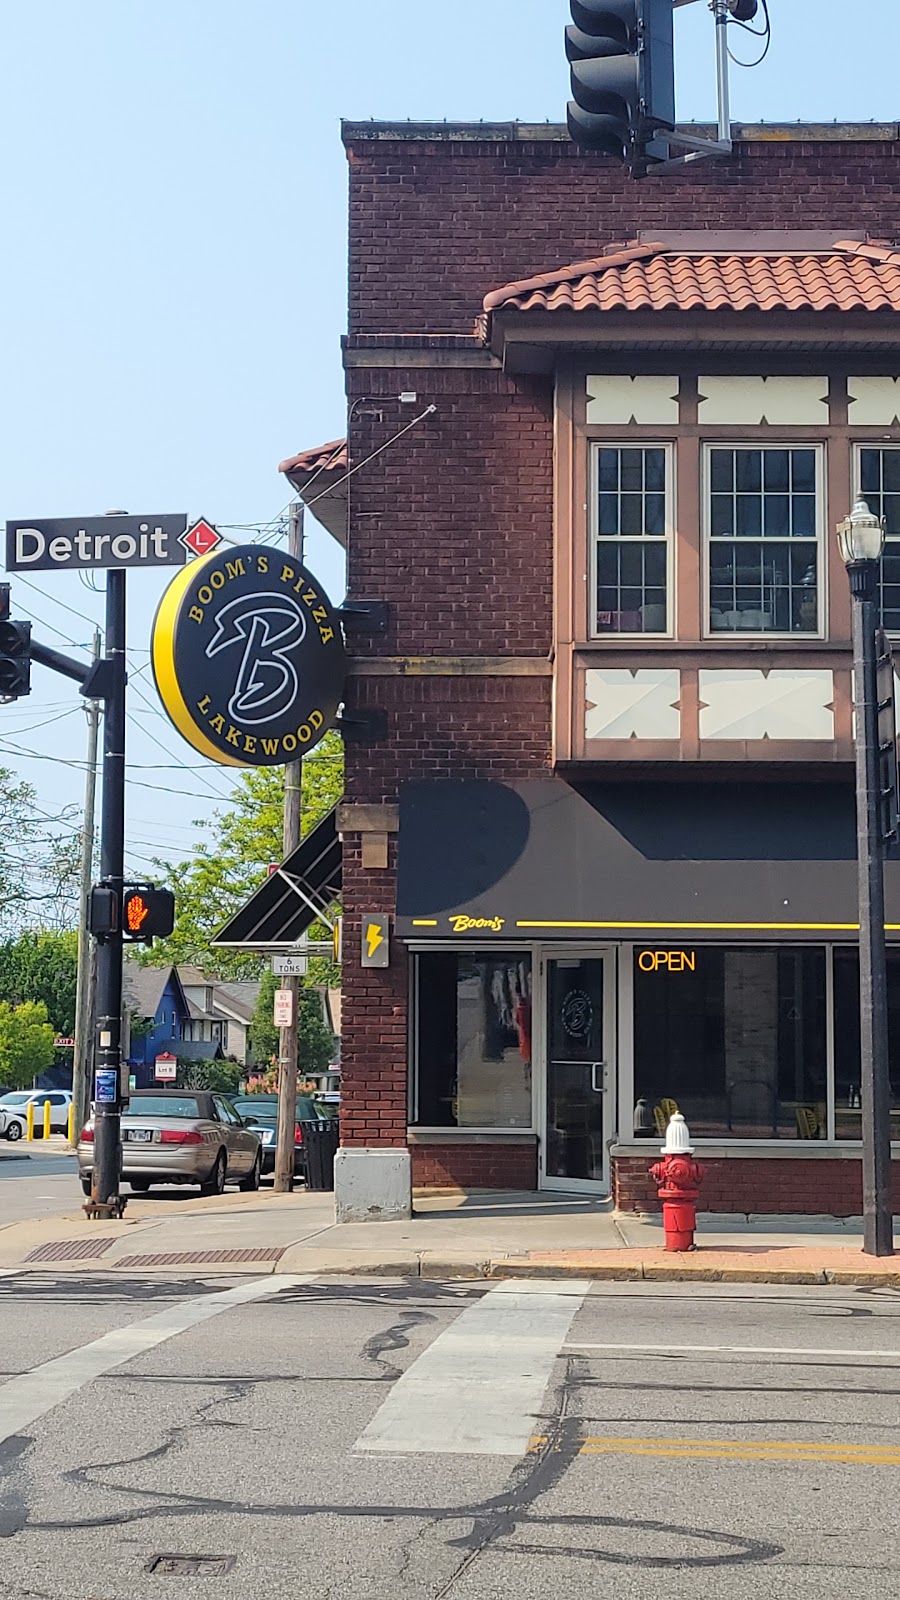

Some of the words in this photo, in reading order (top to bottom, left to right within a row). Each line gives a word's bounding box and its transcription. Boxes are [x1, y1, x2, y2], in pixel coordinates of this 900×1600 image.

[15, 523, 169, 564] Detroit
[195, 532, 209, 546] L
[188, 555, 269, 625] BOOM'S
[280, 564, 335, 645] PIZZA
[205, 591, 307, 725] B
[196, 694, 325, 756] LAKEWOOD
[448, 914, 505, 932] Boom's
[638, 951, 695, 971] OPEN
